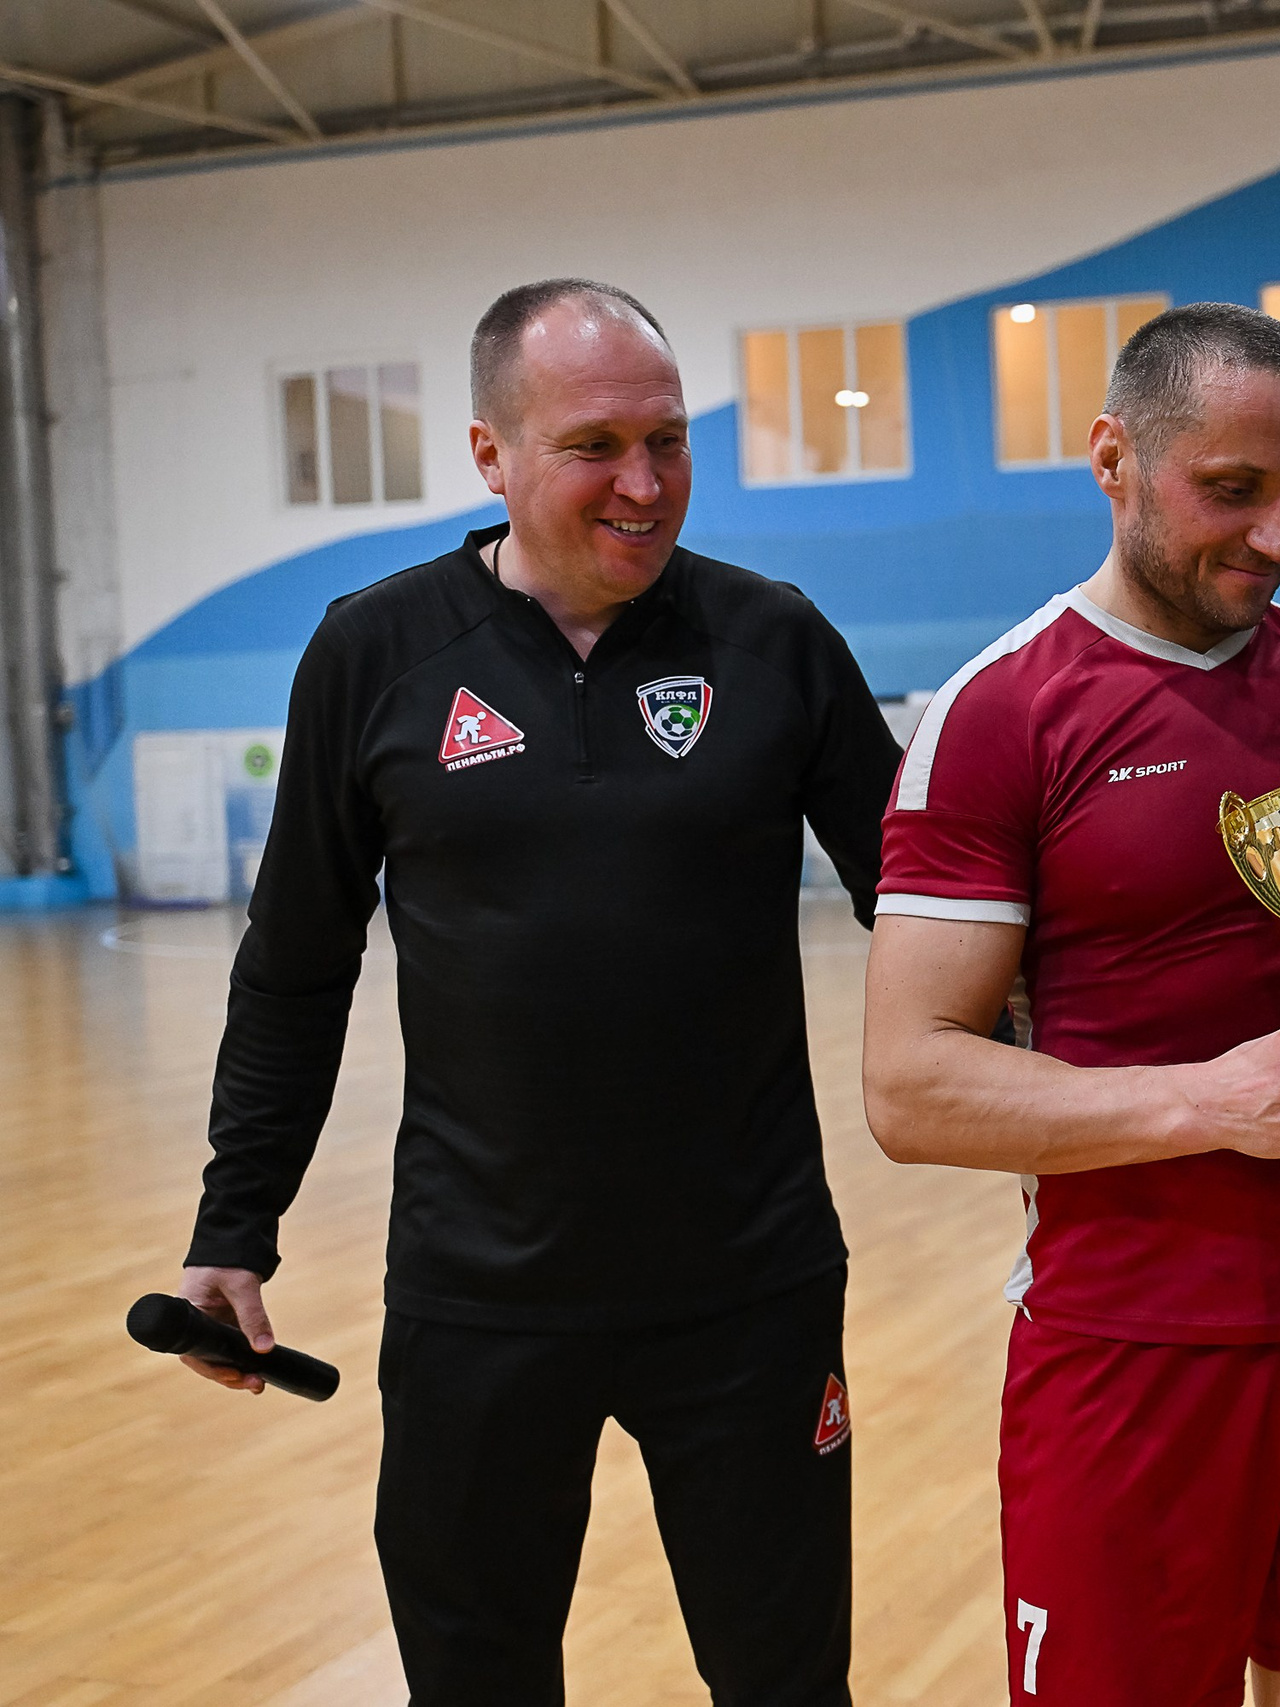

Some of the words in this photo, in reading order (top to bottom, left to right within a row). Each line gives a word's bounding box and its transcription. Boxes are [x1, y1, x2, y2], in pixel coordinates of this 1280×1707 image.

[655, 690, 697, 701] КЛФЛ
[446, 743, 526, 772] ПЕНАЛЬТИ.РФ
[1108, 766, 1134, 783] 2K
[1135, 760, 1187, 777] SPORT
